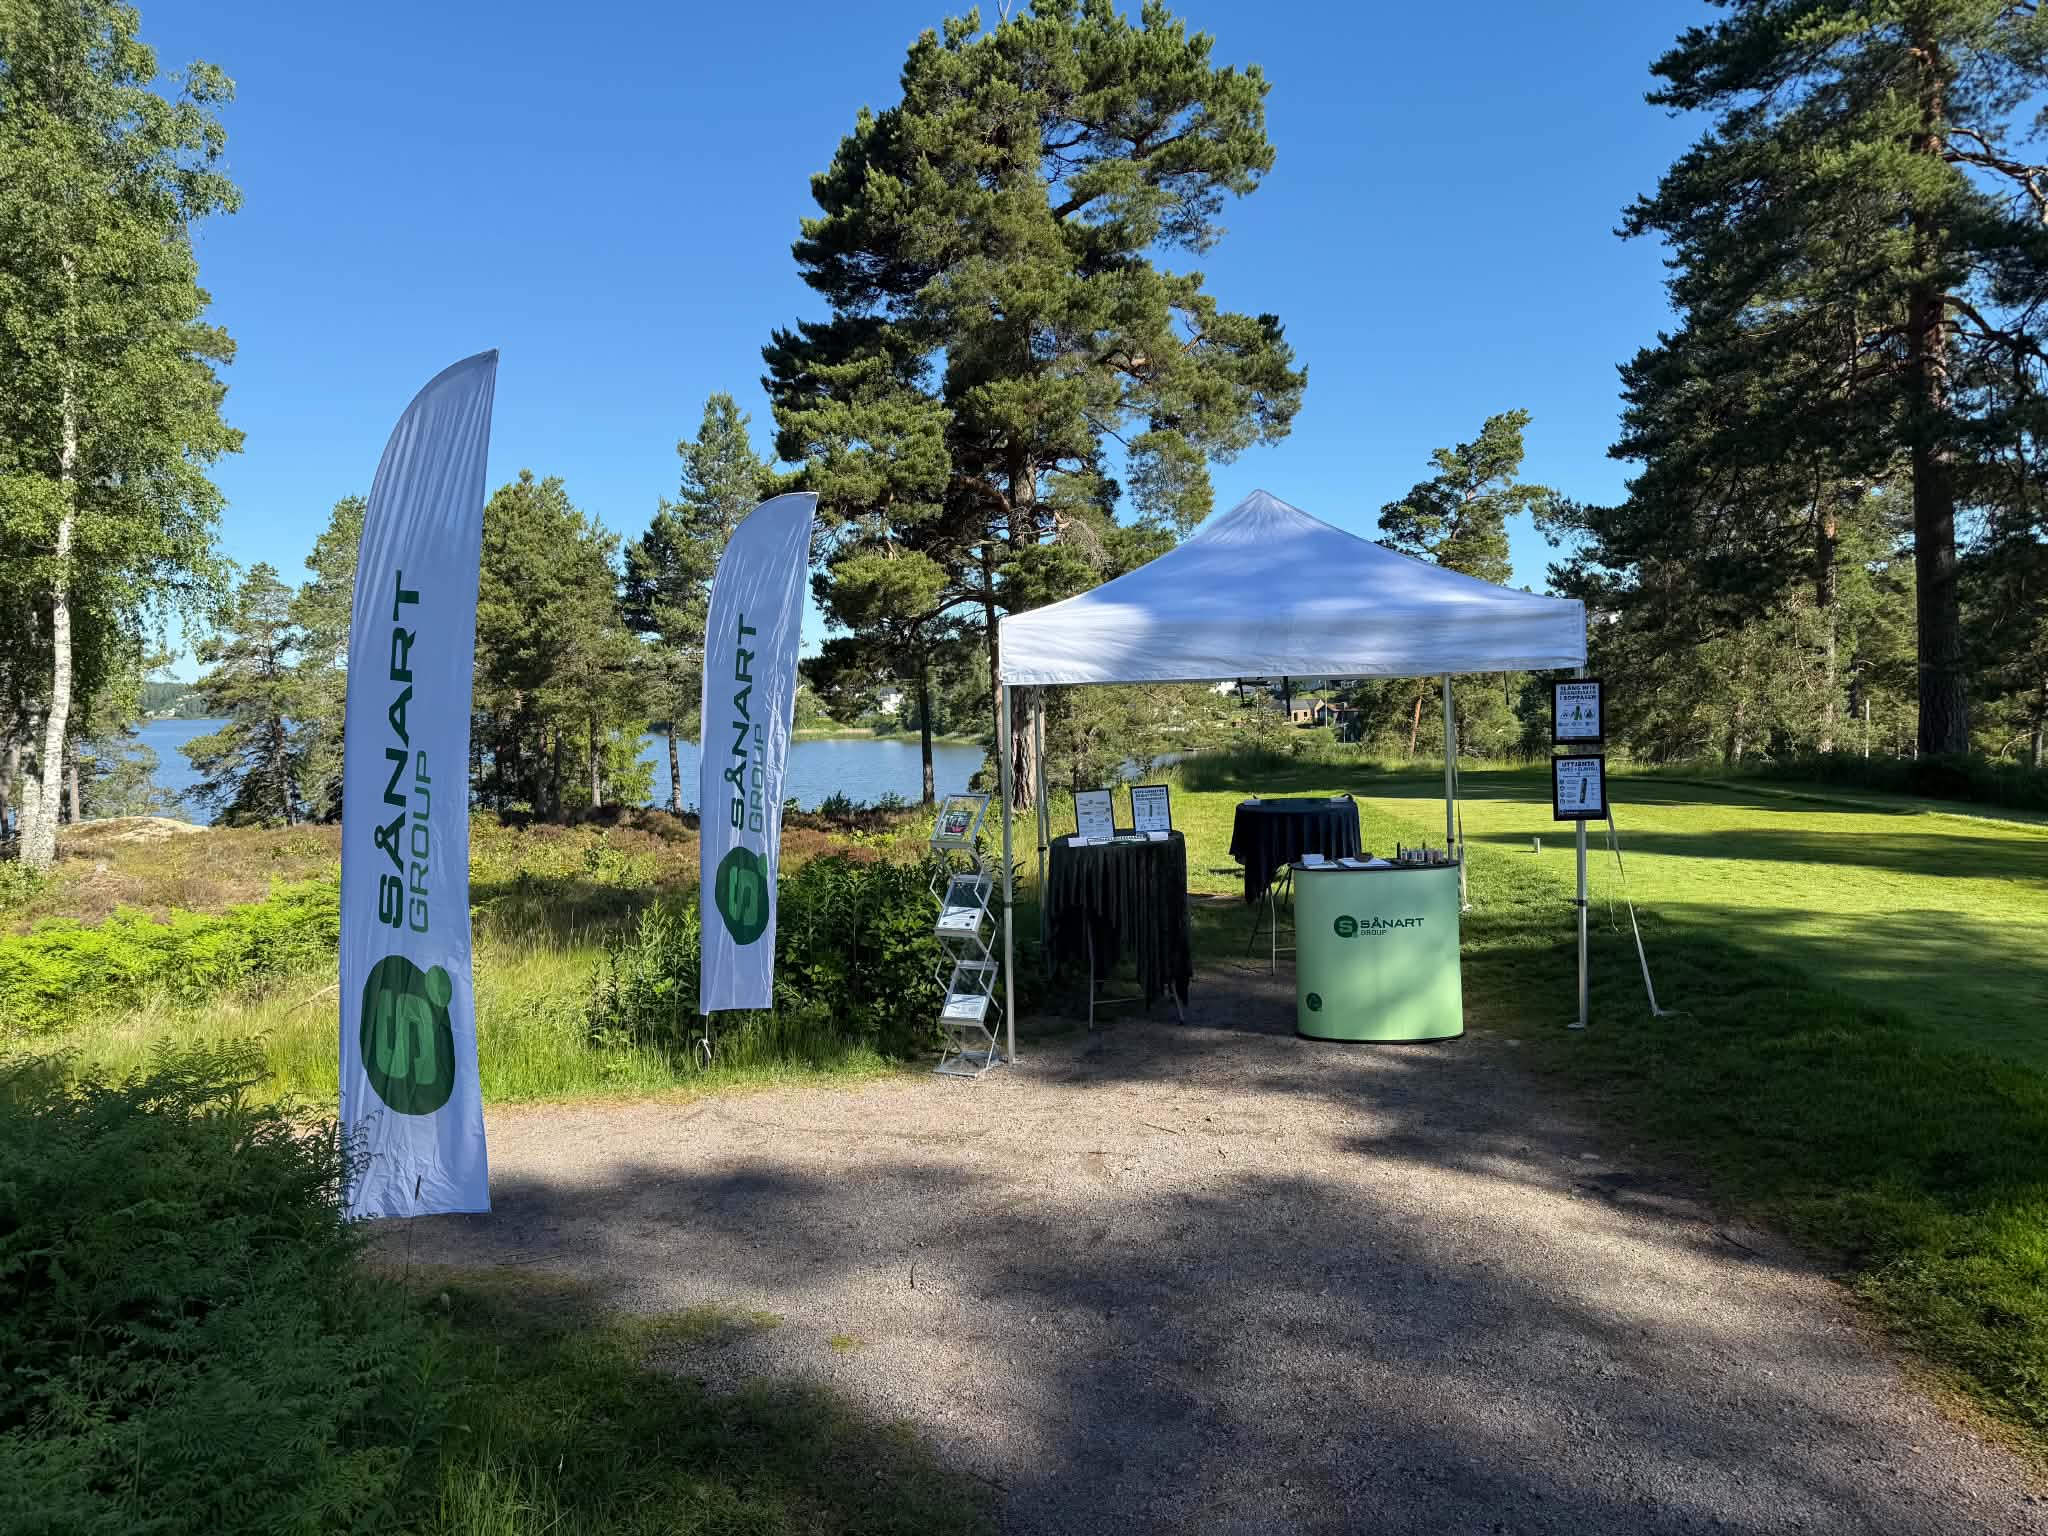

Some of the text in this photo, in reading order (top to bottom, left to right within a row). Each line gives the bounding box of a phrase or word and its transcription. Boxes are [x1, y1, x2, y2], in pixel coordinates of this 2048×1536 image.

[374, 570, 420, 929] SÅNART
[724, 613, 757, 831] SÅNART
[748, 723, 764, 833] GROUP
[409, 751, 432, 934] GROUP
[1360, 917, 1425, 930] SÅNART
